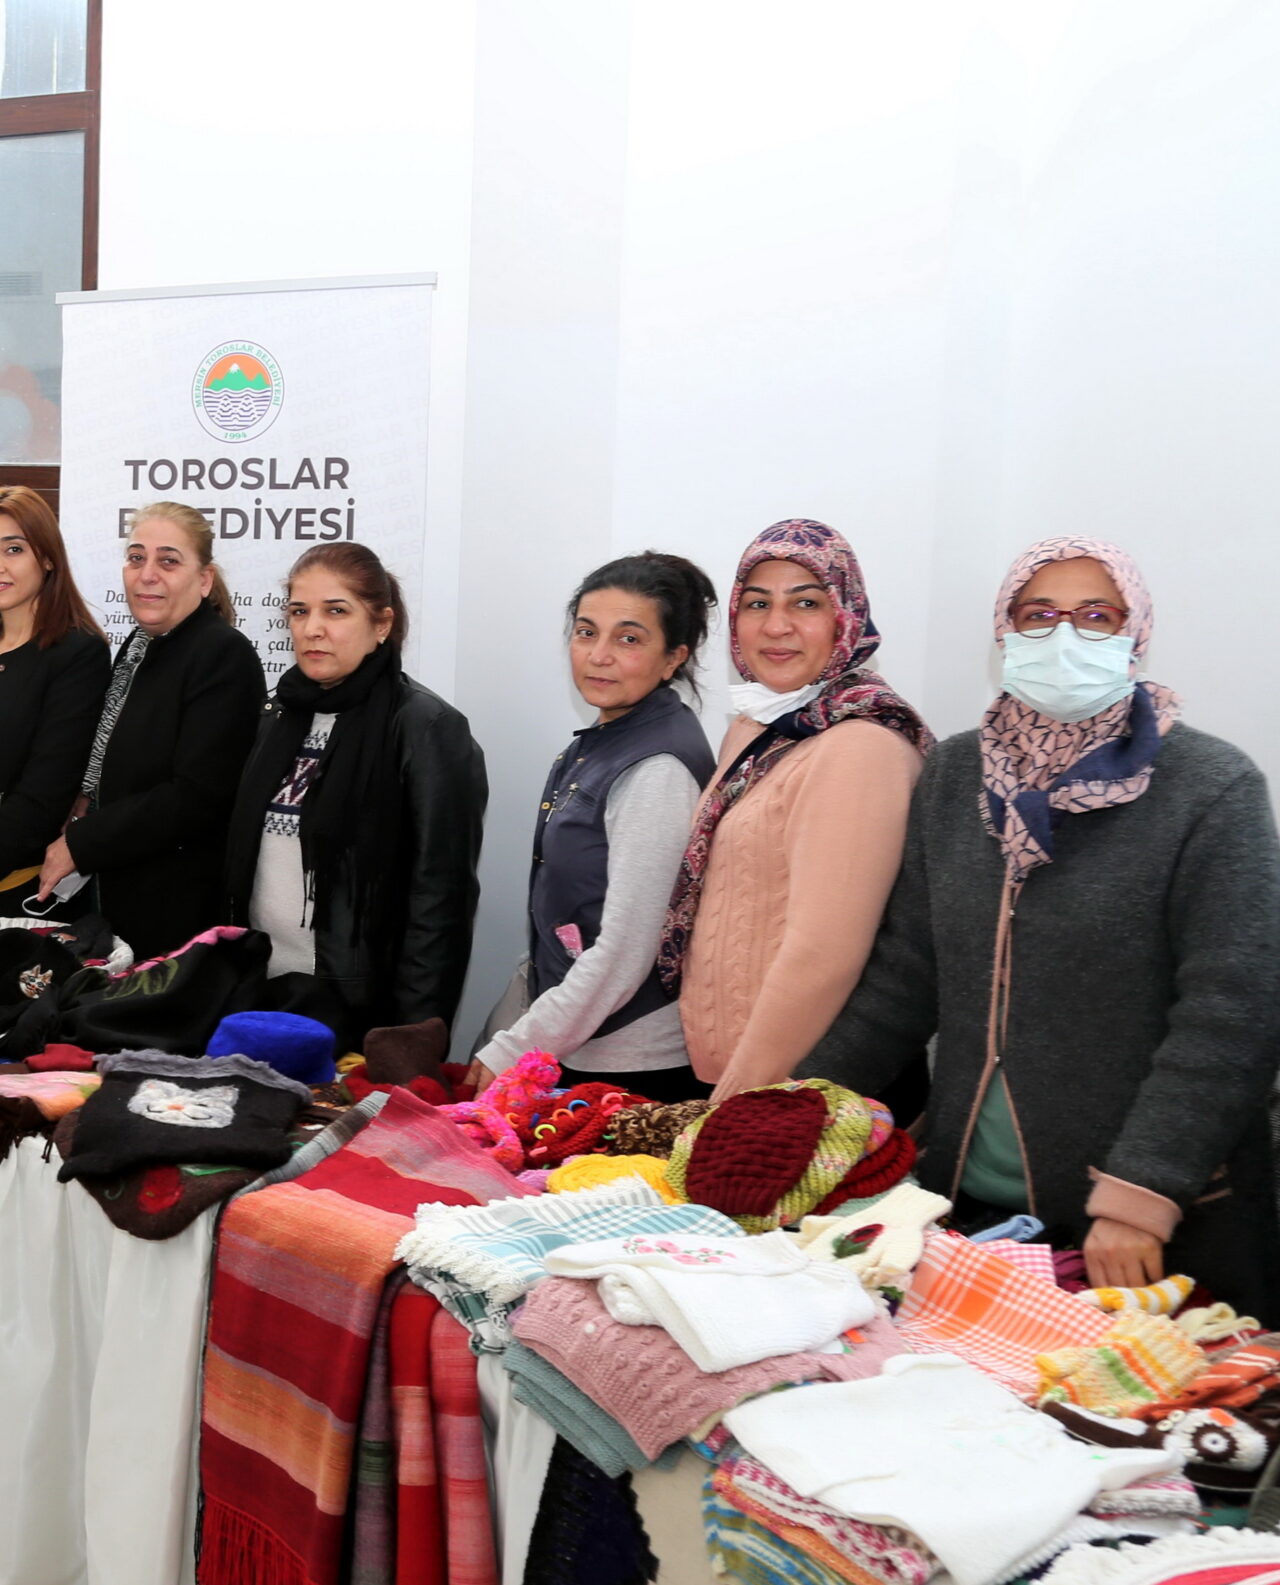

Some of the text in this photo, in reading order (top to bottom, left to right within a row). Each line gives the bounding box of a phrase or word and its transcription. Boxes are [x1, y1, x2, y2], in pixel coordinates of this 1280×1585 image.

[206, 343, 254, 366] TOROSLAR
[124, 457, 351, 490] TOROSLAR
[119, 497, 355, 540] DİYESİ
[104, 589, 128, 603] Da
